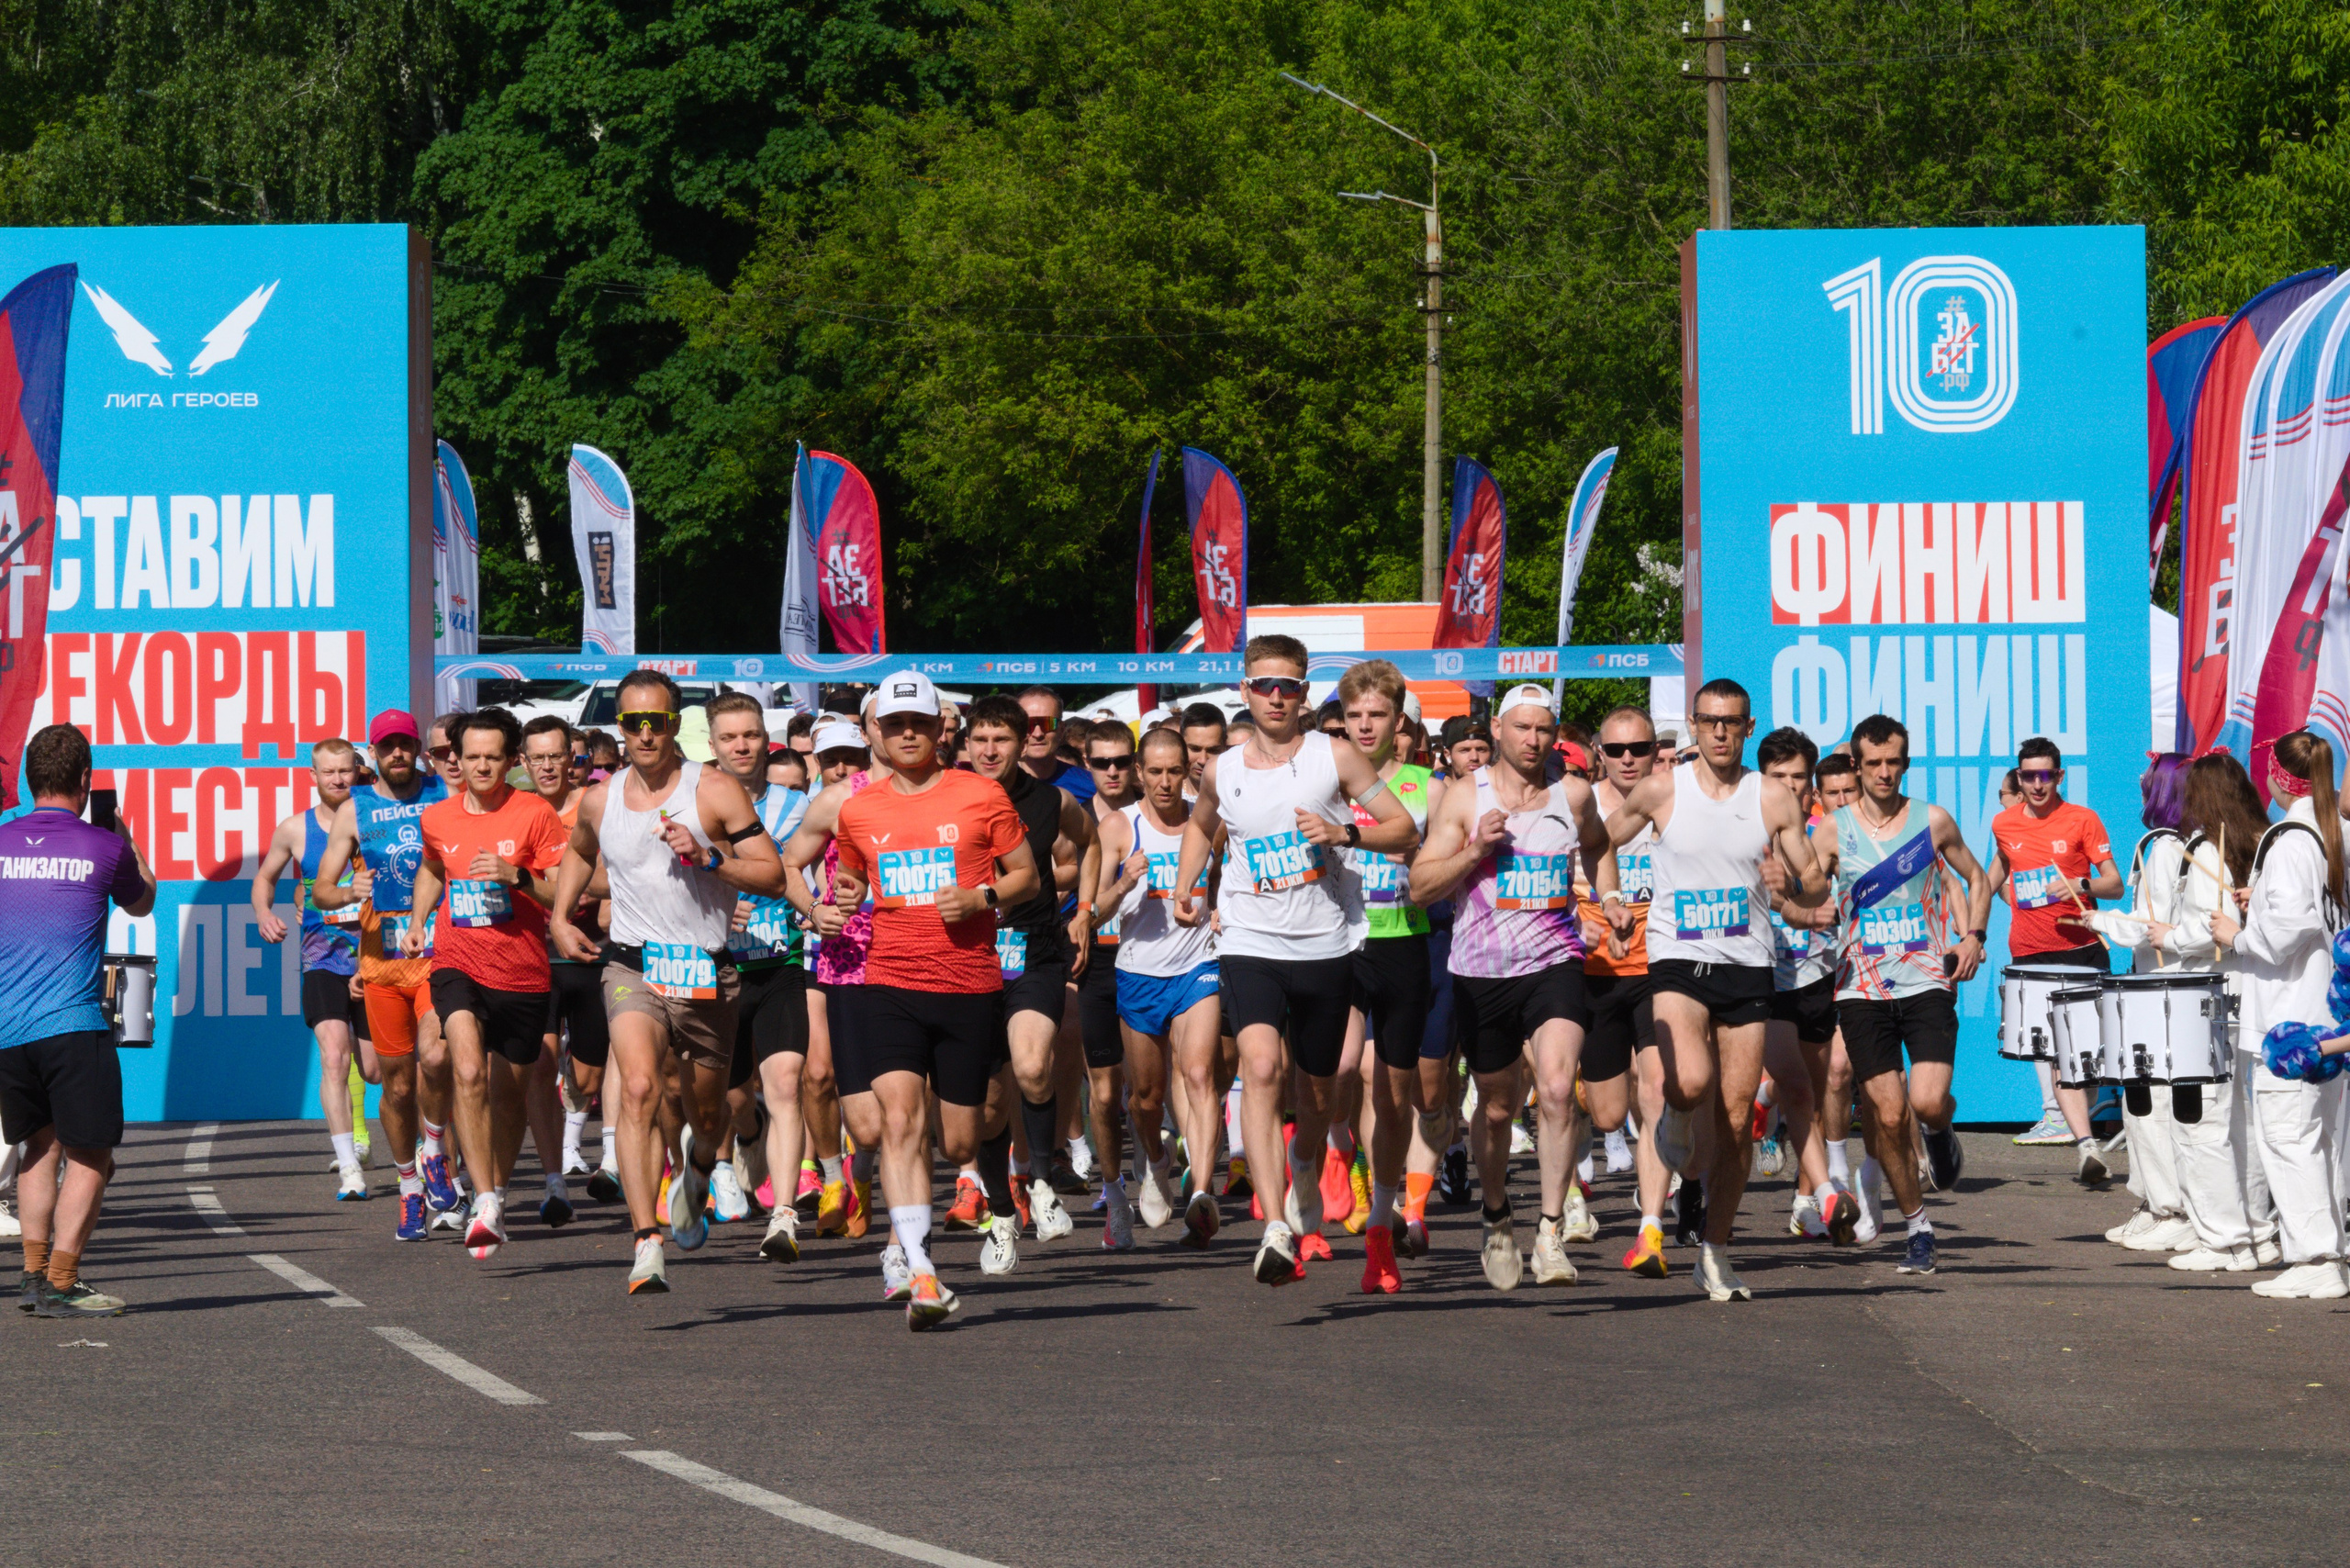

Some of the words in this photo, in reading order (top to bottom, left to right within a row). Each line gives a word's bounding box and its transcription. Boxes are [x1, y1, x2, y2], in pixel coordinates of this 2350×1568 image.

[1937, 312, 1973, 342] ЗА
[1823, 255, 2020, 435] 10
[1930, 342, 1979, 374] БЕГ
[1939, 373, 1969, 392] .рф
[104, 393, 163, 409] ЛИГА
[172, 393, 259, 408] ГЕРОЕВ
[1771, 501, 2087, 627] ФИНИШ
[732, 658, 764, 678] 10
[996, 662, 1037, 673] ПСБ
[1049, 662, 1060, 672] 5
[1116, 662, 1139, 672] 10
[1198, 660, 1231, 673] 21,1
[1432, 652, 1464, 676] 10
[1498, 651, 1558, 674] СТАРТ
[1608, 654, 1649, 667] ПСБ
[36, 631, 366, 759] ЕКОРДЫ
[1772, 633, 2087, 757] ФИНИШ
[936, 823, 960, 844] 10
[497, 839, 516, 857] 10
[2052, 840, 2067, 854] 10
[884, 861, 952, 895] 70075
[1505, 869, 1561, 897] 70154
[453, 888, 504, 916] 50135
[1684, 901, 1740, 929] 50171
[1864, 917, 1921, 945] 50301
[172, 902, 302, 1017] ЛЕТ
[647, 956, 711, 986] 70079
